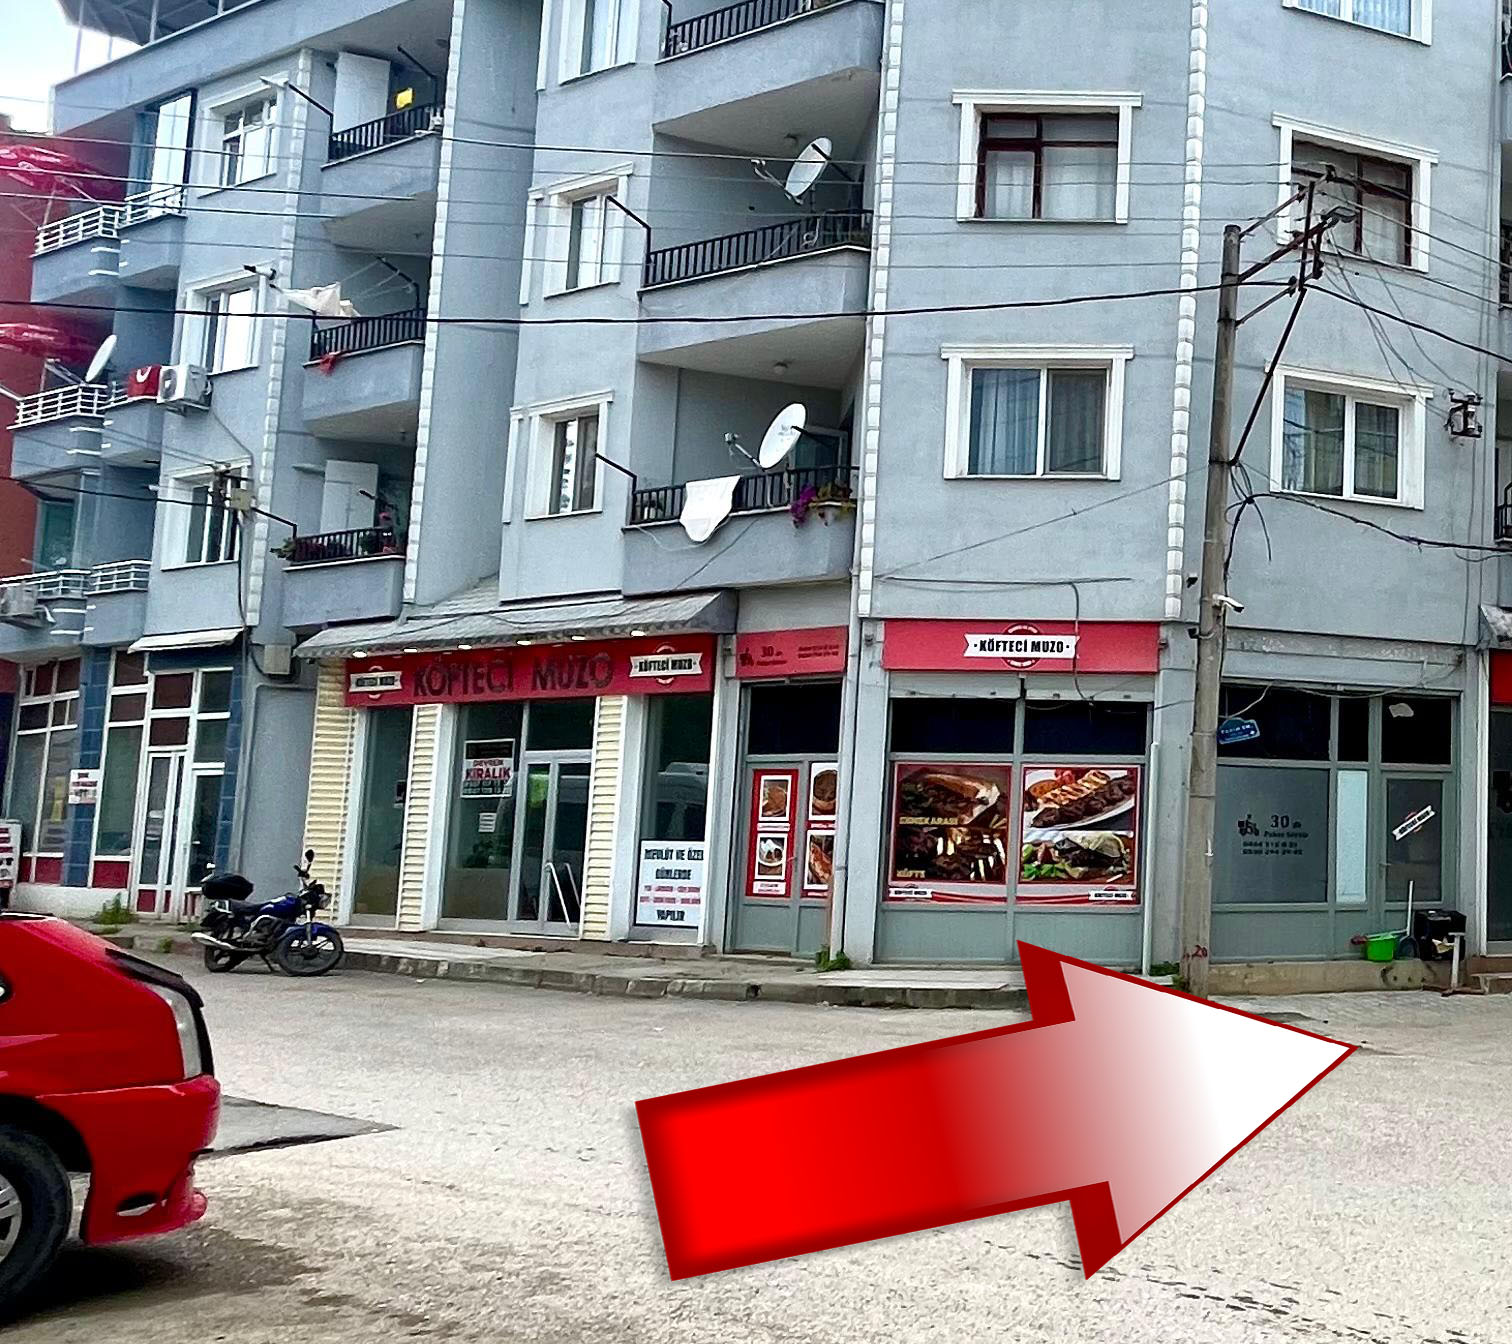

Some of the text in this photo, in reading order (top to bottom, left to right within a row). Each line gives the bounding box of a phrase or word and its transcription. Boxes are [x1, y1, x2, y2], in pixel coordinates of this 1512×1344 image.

[980, 638, 1064, 653] KÖFTECİ MUZO
[531, 652, 614, 692] MUZO
[1270, 814, 1290, 828] 30
